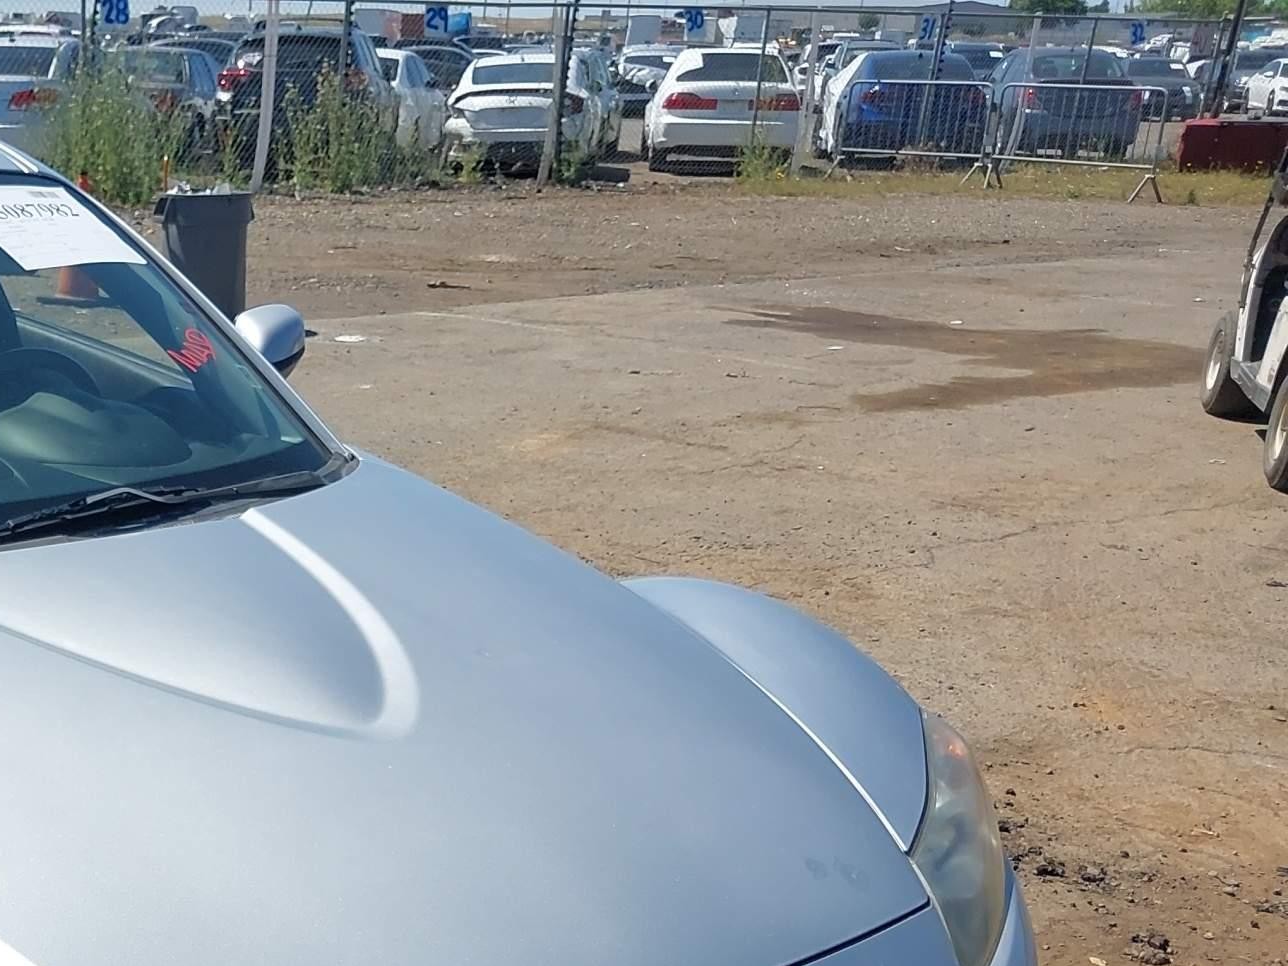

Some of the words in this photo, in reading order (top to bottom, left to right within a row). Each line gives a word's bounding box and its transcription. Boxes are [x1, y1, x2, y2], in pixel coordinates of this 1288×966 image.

[102, 0, 129, 24] 28
[426, 6, 448, 33] 29
[685, 10, 704, 32] 30
[919, 18, 936, 40] 31
[1131, 23, 1146, 44] 32
